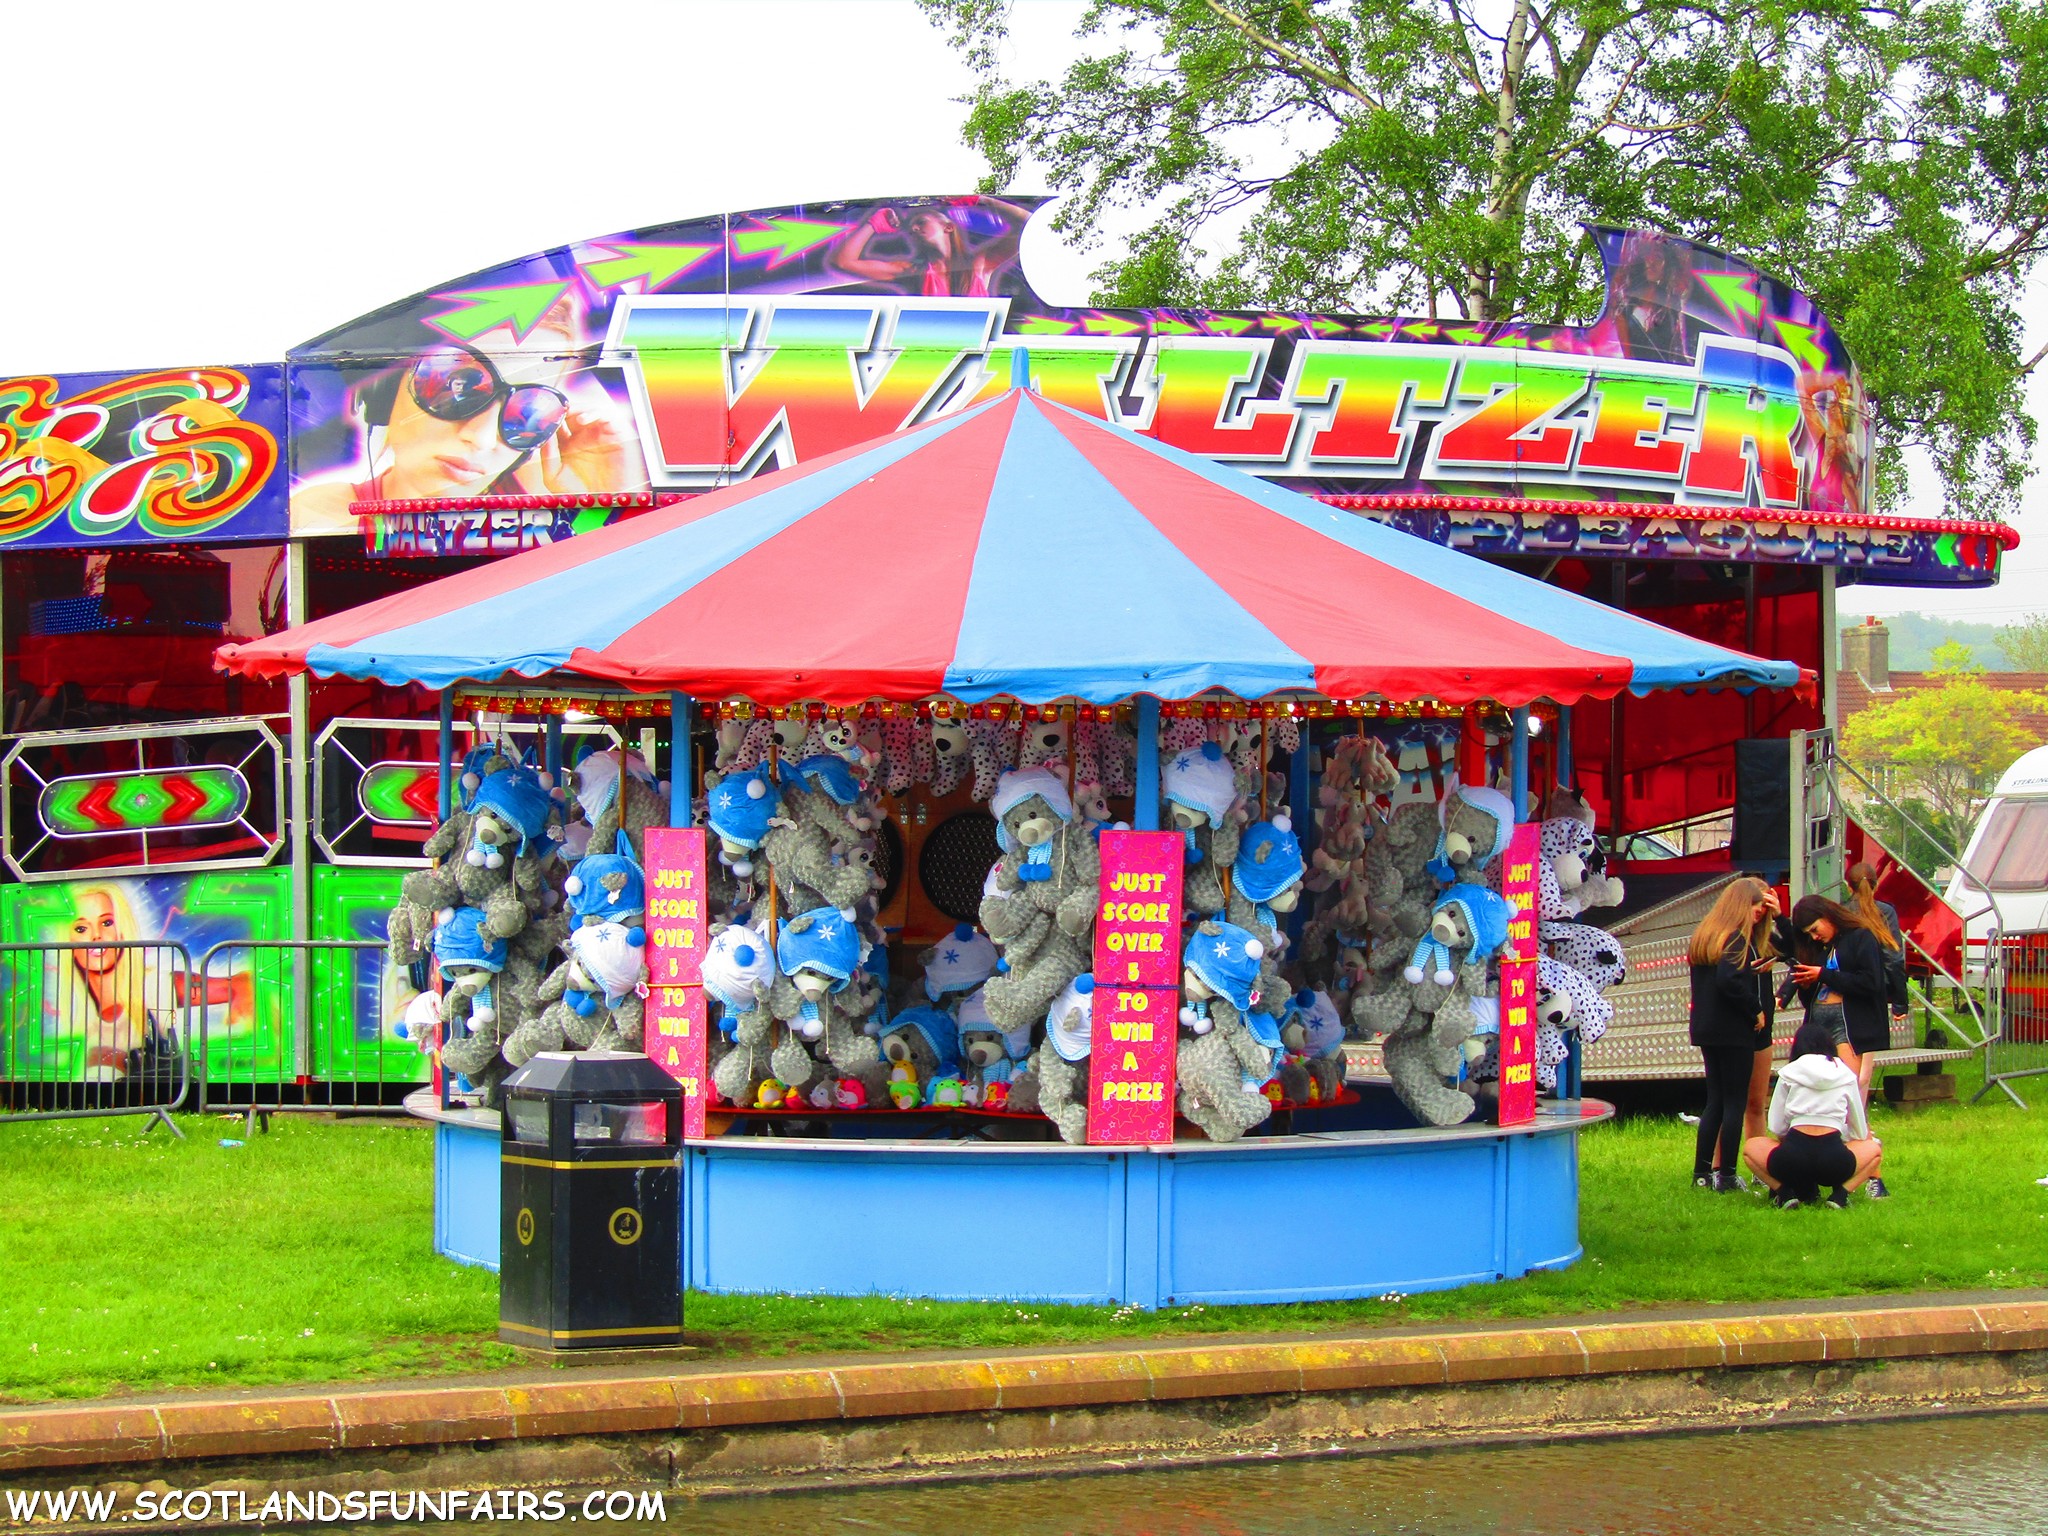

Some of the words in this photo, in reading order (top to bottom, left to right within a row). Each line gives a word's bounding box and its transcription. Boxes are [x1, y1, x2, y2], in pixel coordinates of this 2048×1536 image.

[386, 510, 553, 549] WALTZER
[1449, 510, 1912, 563] PLEASURE
[653, 869, 693, 889] JUST
[1110, 872, 1166, 892] JUST
[1508, 863, 1532, 883] JUST
[650, 898, 698, 919] SCORE
[1102, 902, 1170, 923] SCORE
[653, 928, 694, 948] OVER
[1507, 920, 1531, 940] OVER
[1106, 932, 1163, 952] OVER
[669, 958, 678, 977] 5
[1128, 962, 1140, 981] 5
[663, 987, 685, 1007] TO
[1511, 978, 1525, 998] TO
[1117, 992, 1148, 1012] TO
[1514, 1036, 1521, 1054] A
[667, 1046, 680, 1066] A
[1122, 1052, 1138, 1071] A
